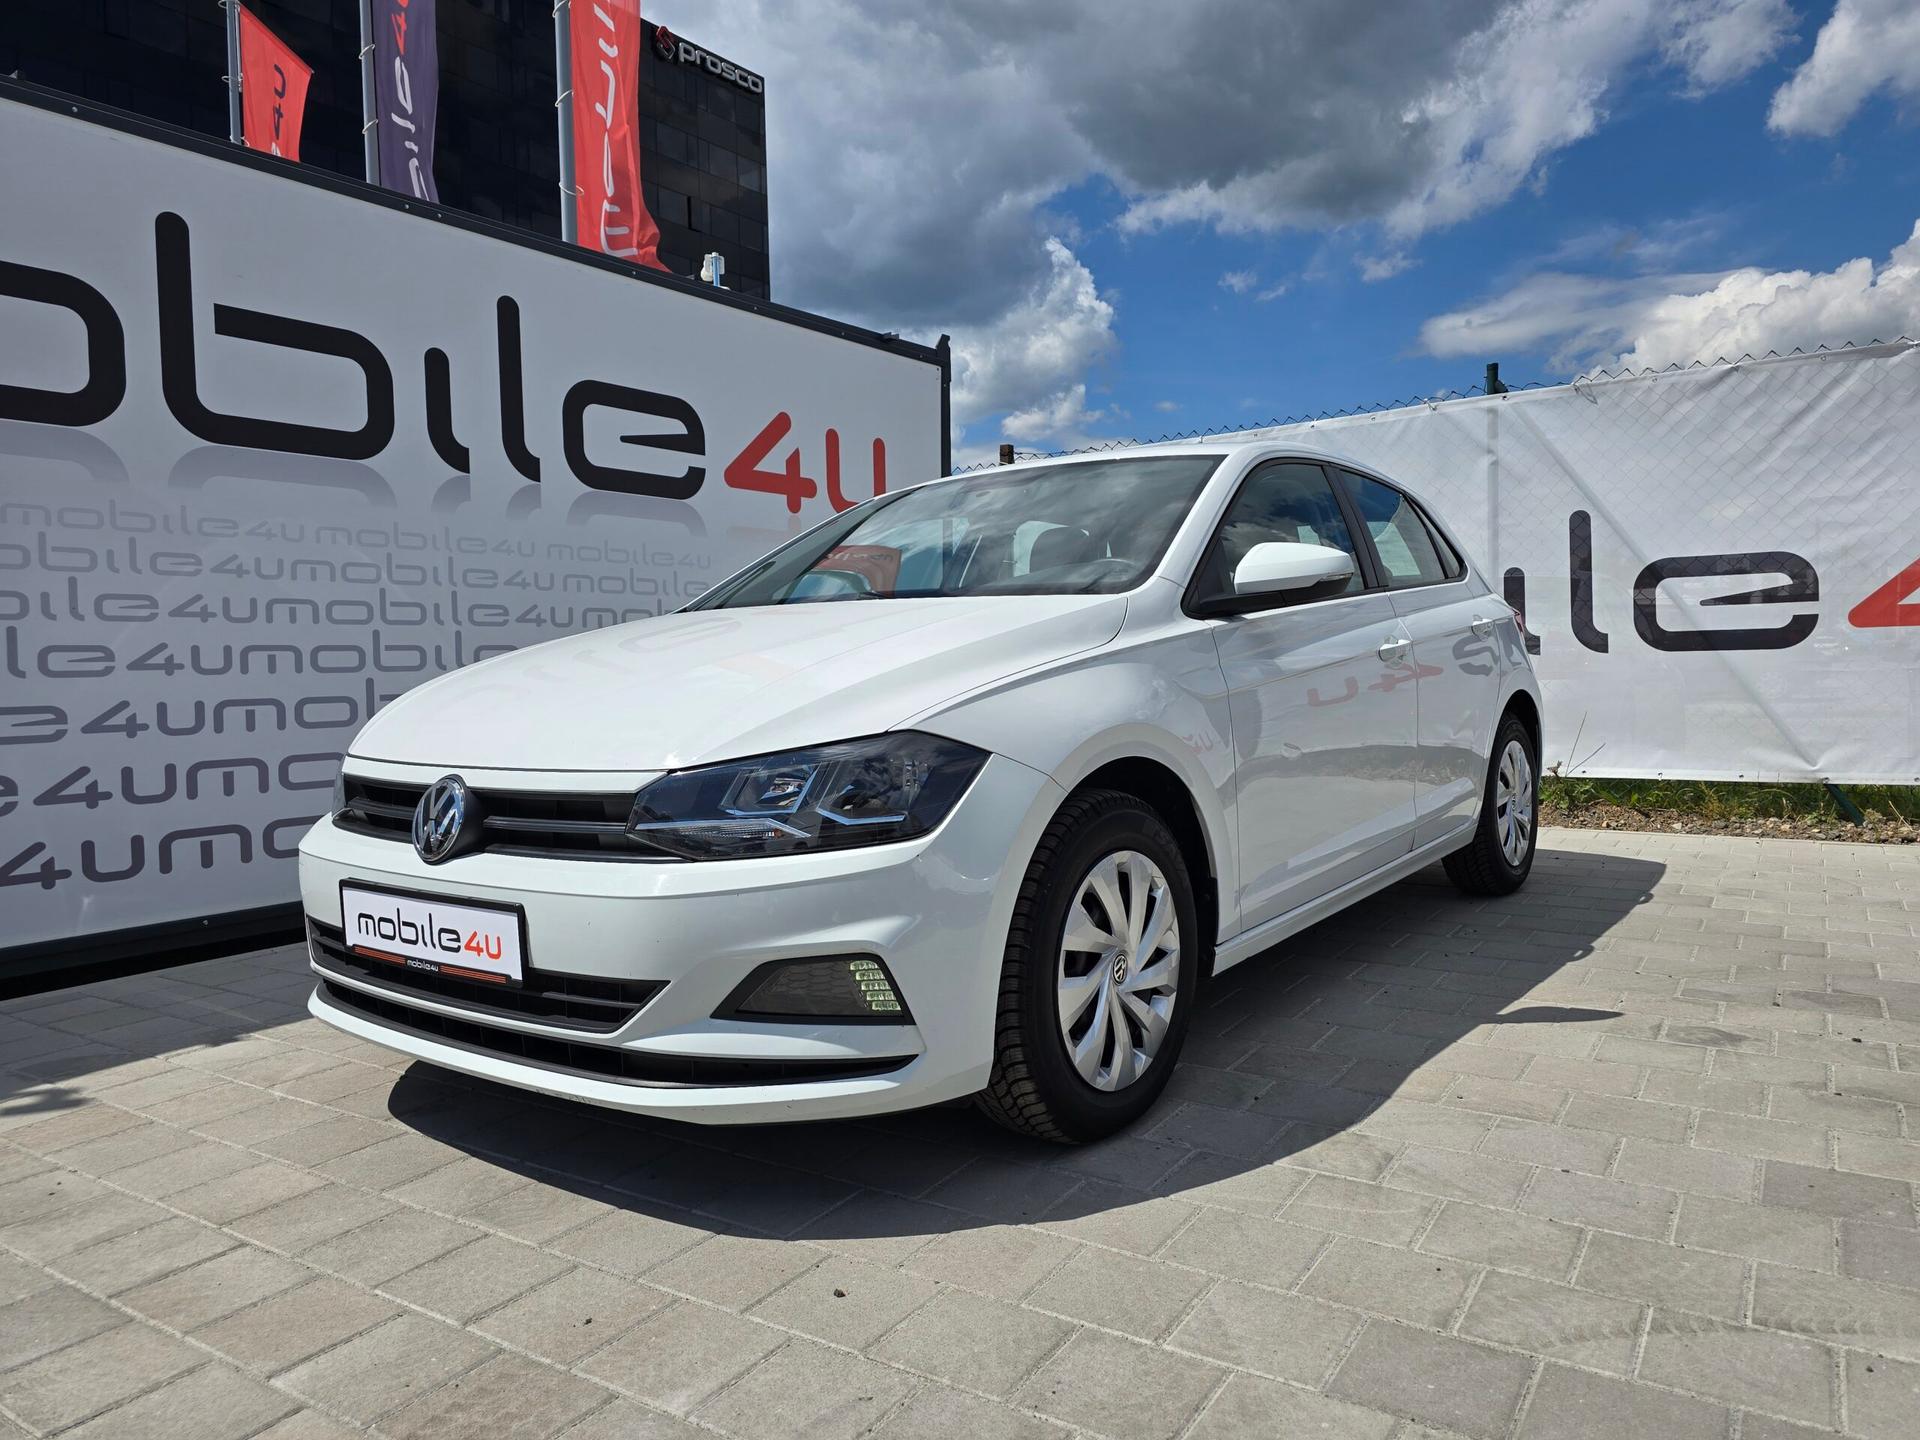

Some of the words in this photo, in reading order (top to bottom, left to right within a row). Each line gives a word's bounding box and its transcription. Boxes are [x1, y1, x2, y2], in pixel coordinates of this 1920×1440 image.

[678, 41, 763, 94] prosco
[315, 521, 536, 557] mobile4u
[547, 540, 712, 569] mobile4u
